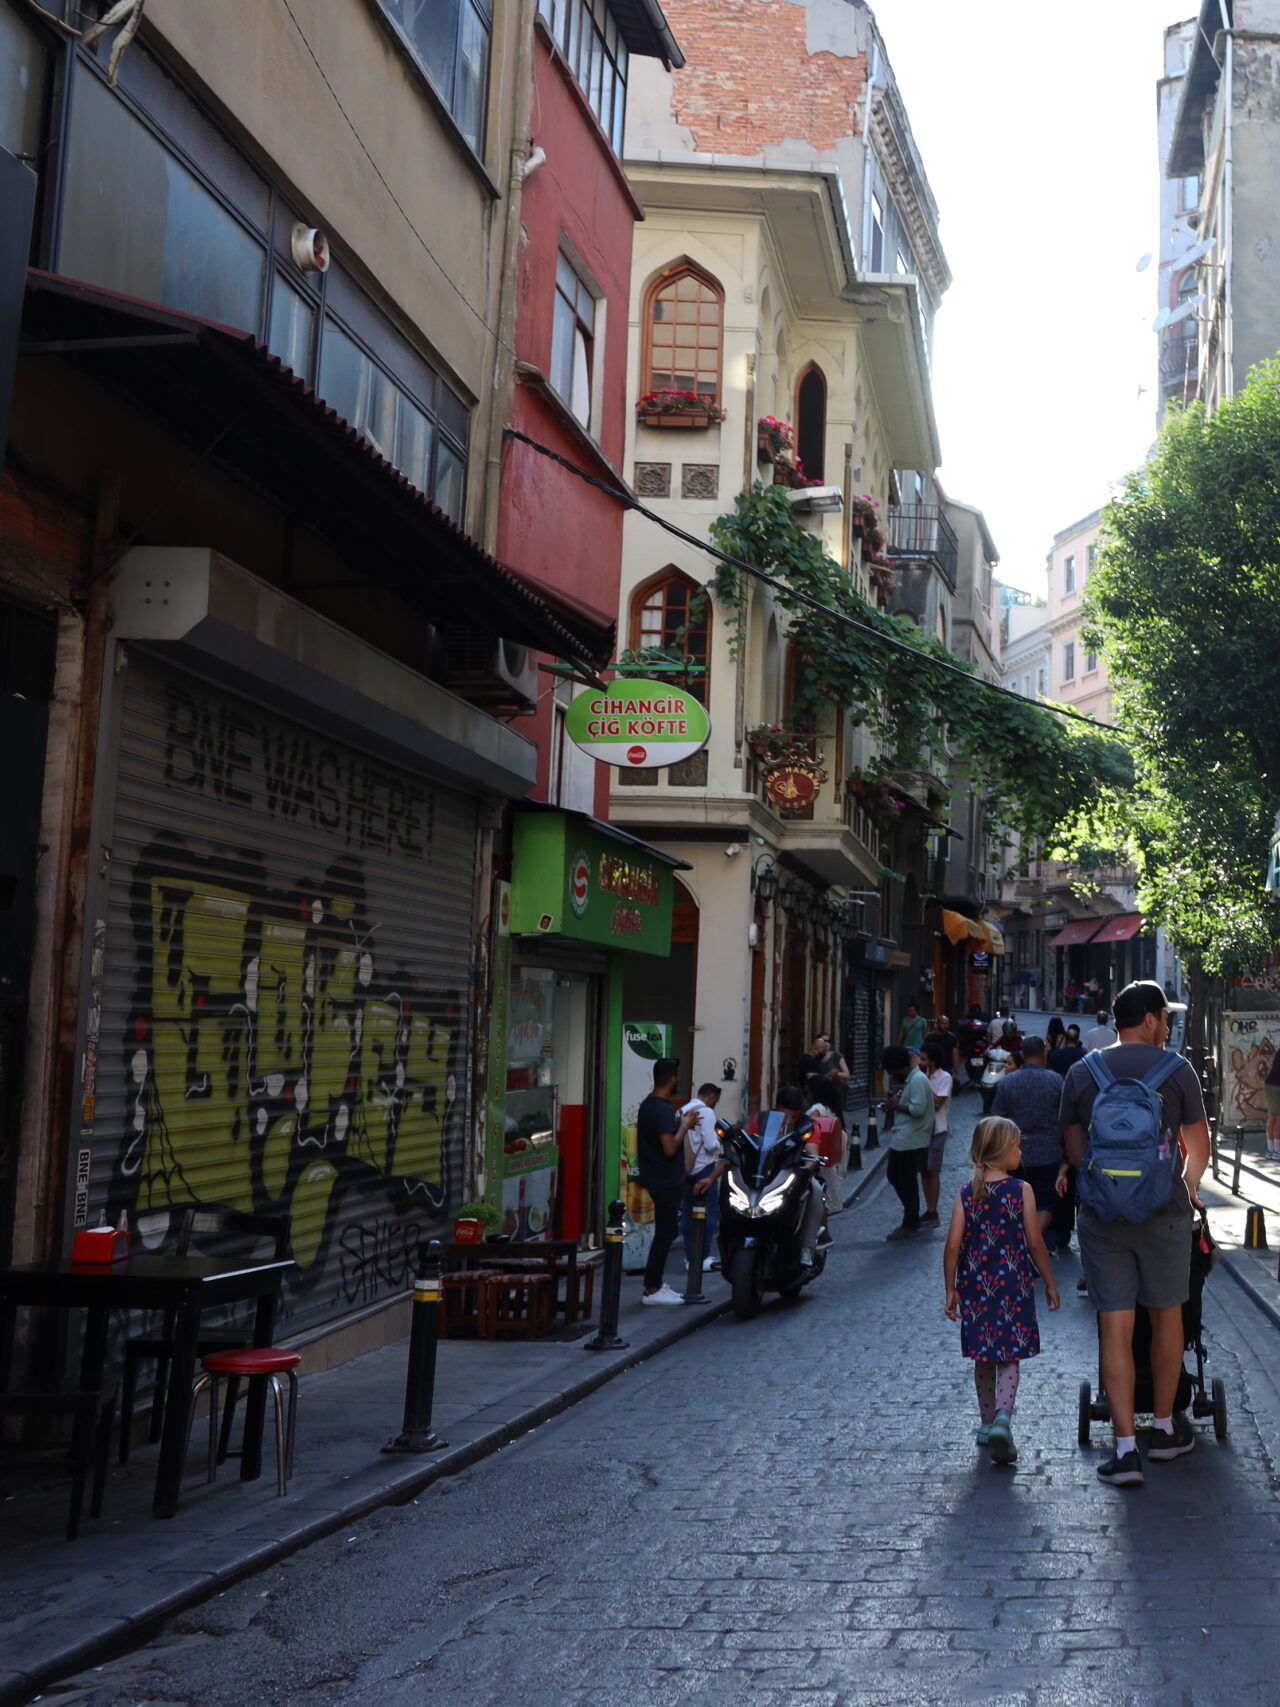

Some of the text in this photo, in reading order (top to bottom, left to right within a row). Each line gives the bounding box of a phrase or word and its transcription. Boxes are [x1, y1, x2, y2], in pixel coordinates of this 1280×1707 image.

[590, 696, 686, 714] CİHANGİR
[587, 717, 687, 739] ÇİĞ KÖFTE
[79, 1152, 90, 1184] BNE
[75, 1192, 87, 1225] BNE
